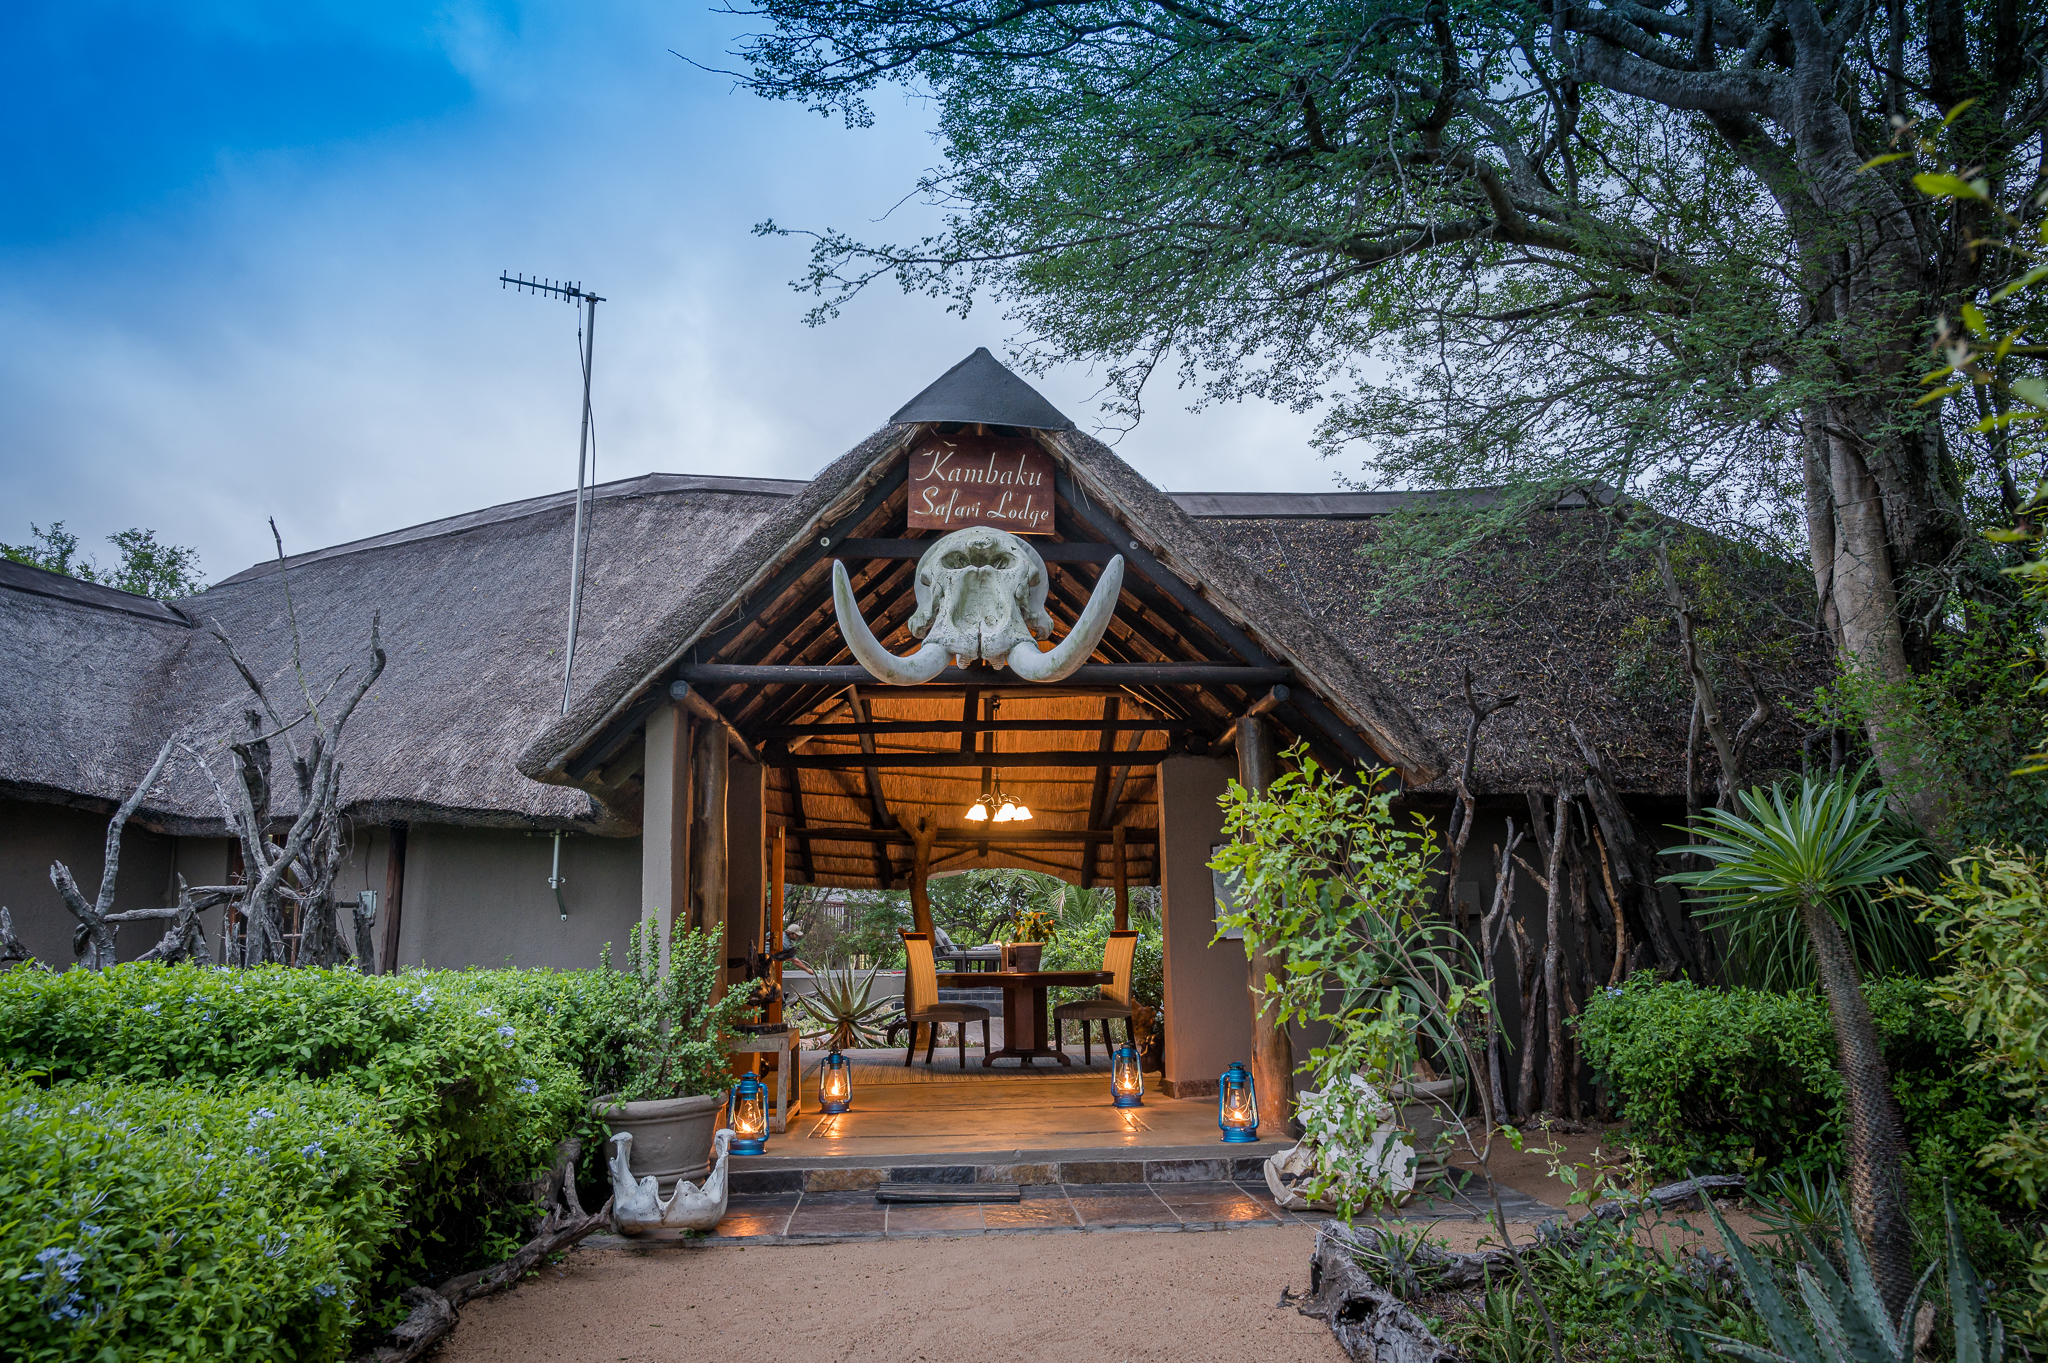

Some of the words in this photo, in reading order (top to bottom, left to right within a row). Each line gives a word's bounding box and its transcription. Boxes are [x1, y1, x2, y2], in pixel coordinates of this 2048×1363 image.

[915, 451, 1042, 486] Kambaku
[914, 486, 981, 524] Safari
[986, 490, 1049, 528] Lodge
